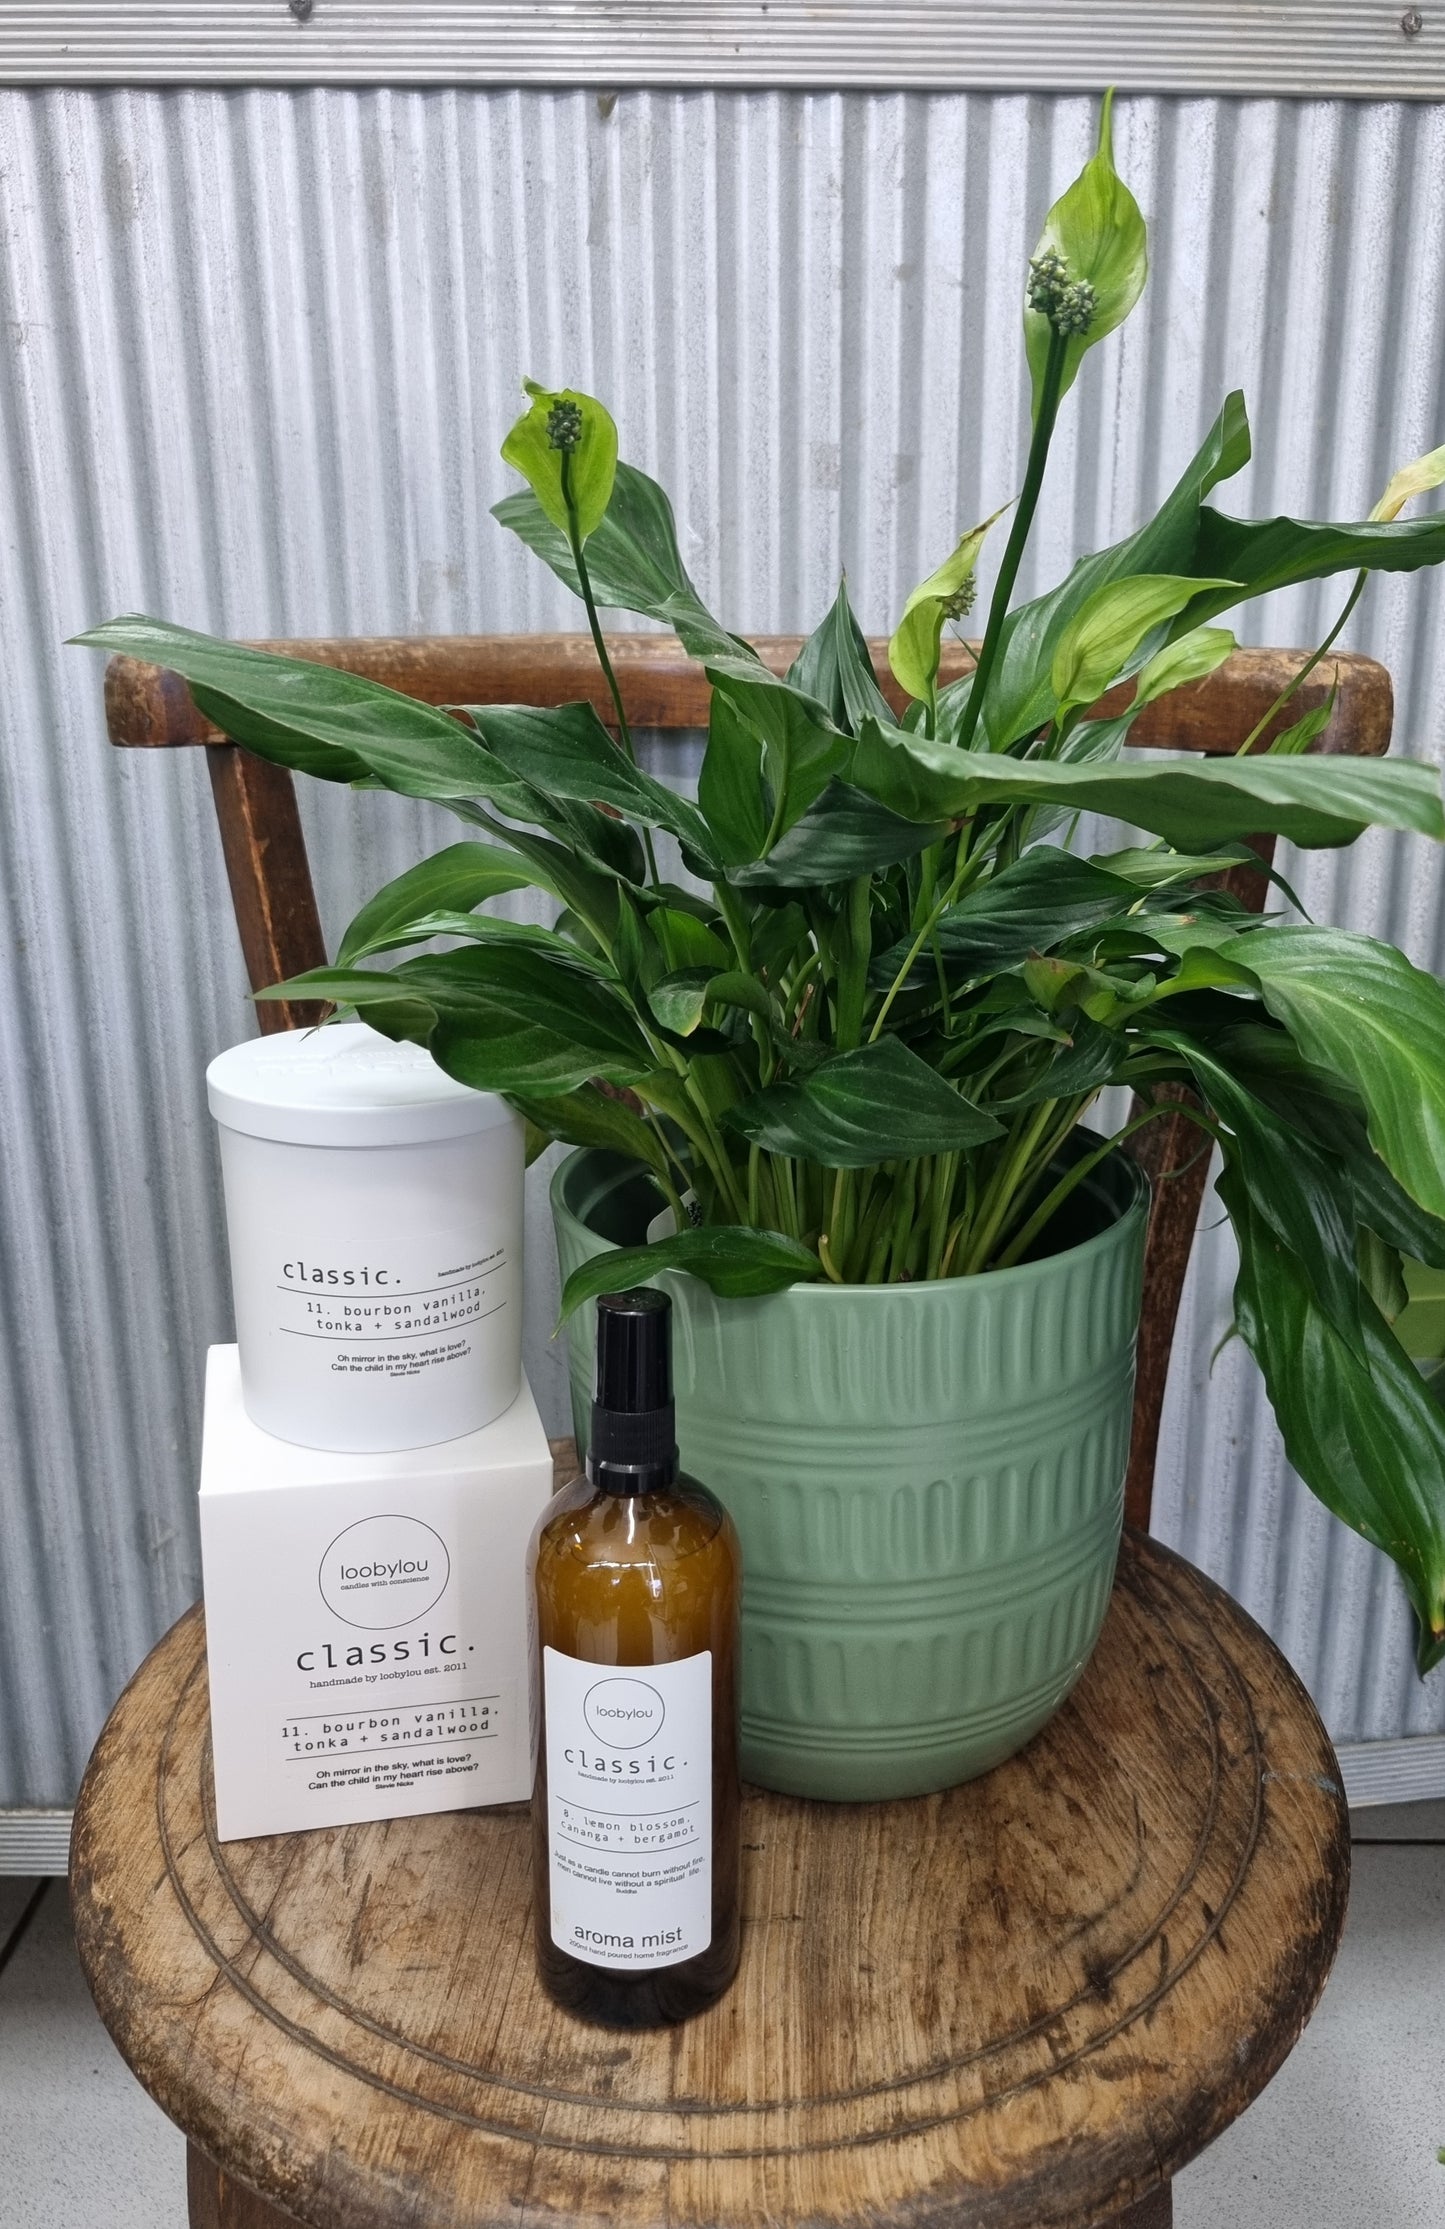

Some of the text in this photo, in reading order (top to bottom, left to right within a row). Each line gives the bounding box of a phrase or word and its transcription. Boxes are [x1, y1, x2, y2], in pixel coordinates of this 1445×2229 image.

[283, 1262, 401, 1285] classic.
[307, 1302, 330, 1315] 11.
[344, 1305, 412, 1316] bourbon
[317, 1301, 480, 1331] tonka + sandalwood
[331, 1347, 471, 1372] Can the child in my heart rise above?
[337, 1354, 350, 1362] Oh
[351, 1355, 376, 1363] mirror
[377, 1353, 385, 1362] in
[387, 1353, 400, 1361] the
[419, 1347, 438, 1358] what
[440, 1345, 446, 1353] is
[447, 1339, 466, 1351] love?
[341, 1559, 428, 1580] loobylou
[340, 1575, 430, 1591] candles with conscience
[297, 1632, 474, 1671] classic.
[309, 1662, 467, 1689] handmade by loobylou est. 2011
[596, 1705, 653, 1720] loobylou
[282, 1726, 308, 1738] 11.
[323, 1717, 400, 1734] bourbon
[294, 1738, 348, 1751] tonka
[380, 1720, 489, 1742] sandalwood
[316, 1770, 330, 1779] Oh
[333, 1768, 361, 1777] mirror
[374, 1764, 389, 1772] the
[412, 1759, 434, 1768] what
[436, 1757, 444, 1765] is
[447, 1753, 472, 1763] love?
[564, 1749, 688, 1774] classic.
[308, 1763, 479, 1790] Can the child in my heart rise above?
[561, 1820, 609, 1842] cananga
[634, 1825, 694, 1843] bergamot
[584, 1816, 620, 1831] lemon
[557, 1861, 571, 1873] men
[572, 1869, 597, 1883] cannot
[599, 1876, 612, 1886] live
[615, 1880, 644, 1888] without
[654, 1872, 686, 1887] spiritual
[567, 1859, 576, 1867] as
[584, 1865, 610, 1876] candle
[611, 1870, 639, 1878] cannot
[642, 1870, 661, 1878] burn
[663, 1861, 690, 1875] without
[574, 1926, 682, 1948] aroma mist
[569, 1938, 588, 1952] 200ml
[589, 1947, 606, 1956] hand
[607, 1951, 632, 1960] poured
[656, 1943, 689, 1957] fragrance
